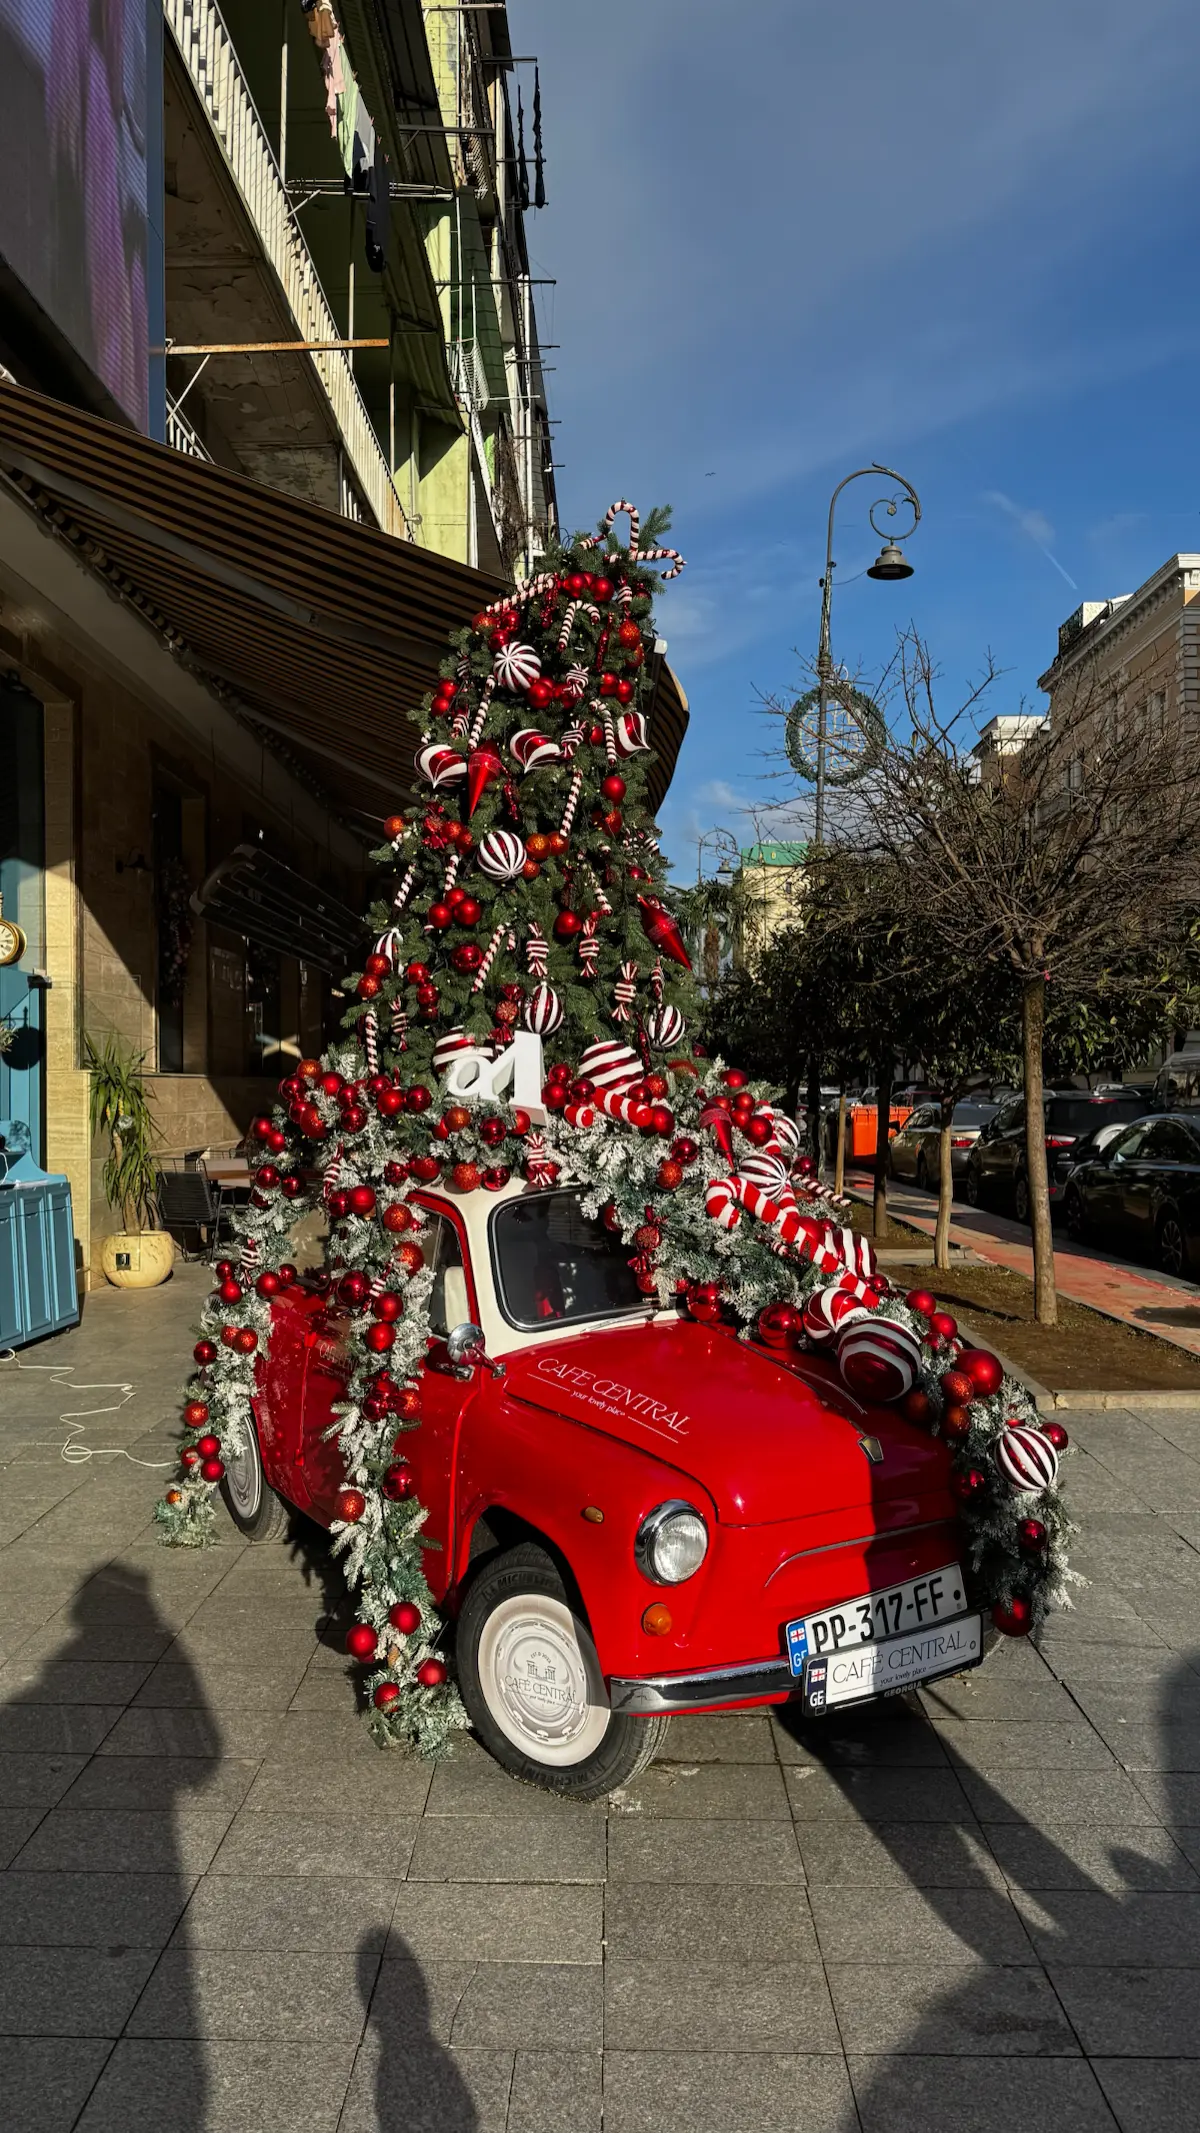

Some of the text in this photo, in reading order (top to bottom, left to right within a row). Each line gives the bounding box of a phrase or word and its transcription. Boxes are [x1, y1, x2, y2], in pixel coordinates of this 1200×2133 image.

[592, 1379, 690, 1435] CENTRAL
[812, 1576, 944, 1654] PP-317-FF
[833, 1630, 968, 1684] CAFÉ CENTRAL
[880, 1666, 927, 1687] your lovely place
[883, 1681, 922, 1698] GEORGIA
[809, 1690, 825, 1707] GE
